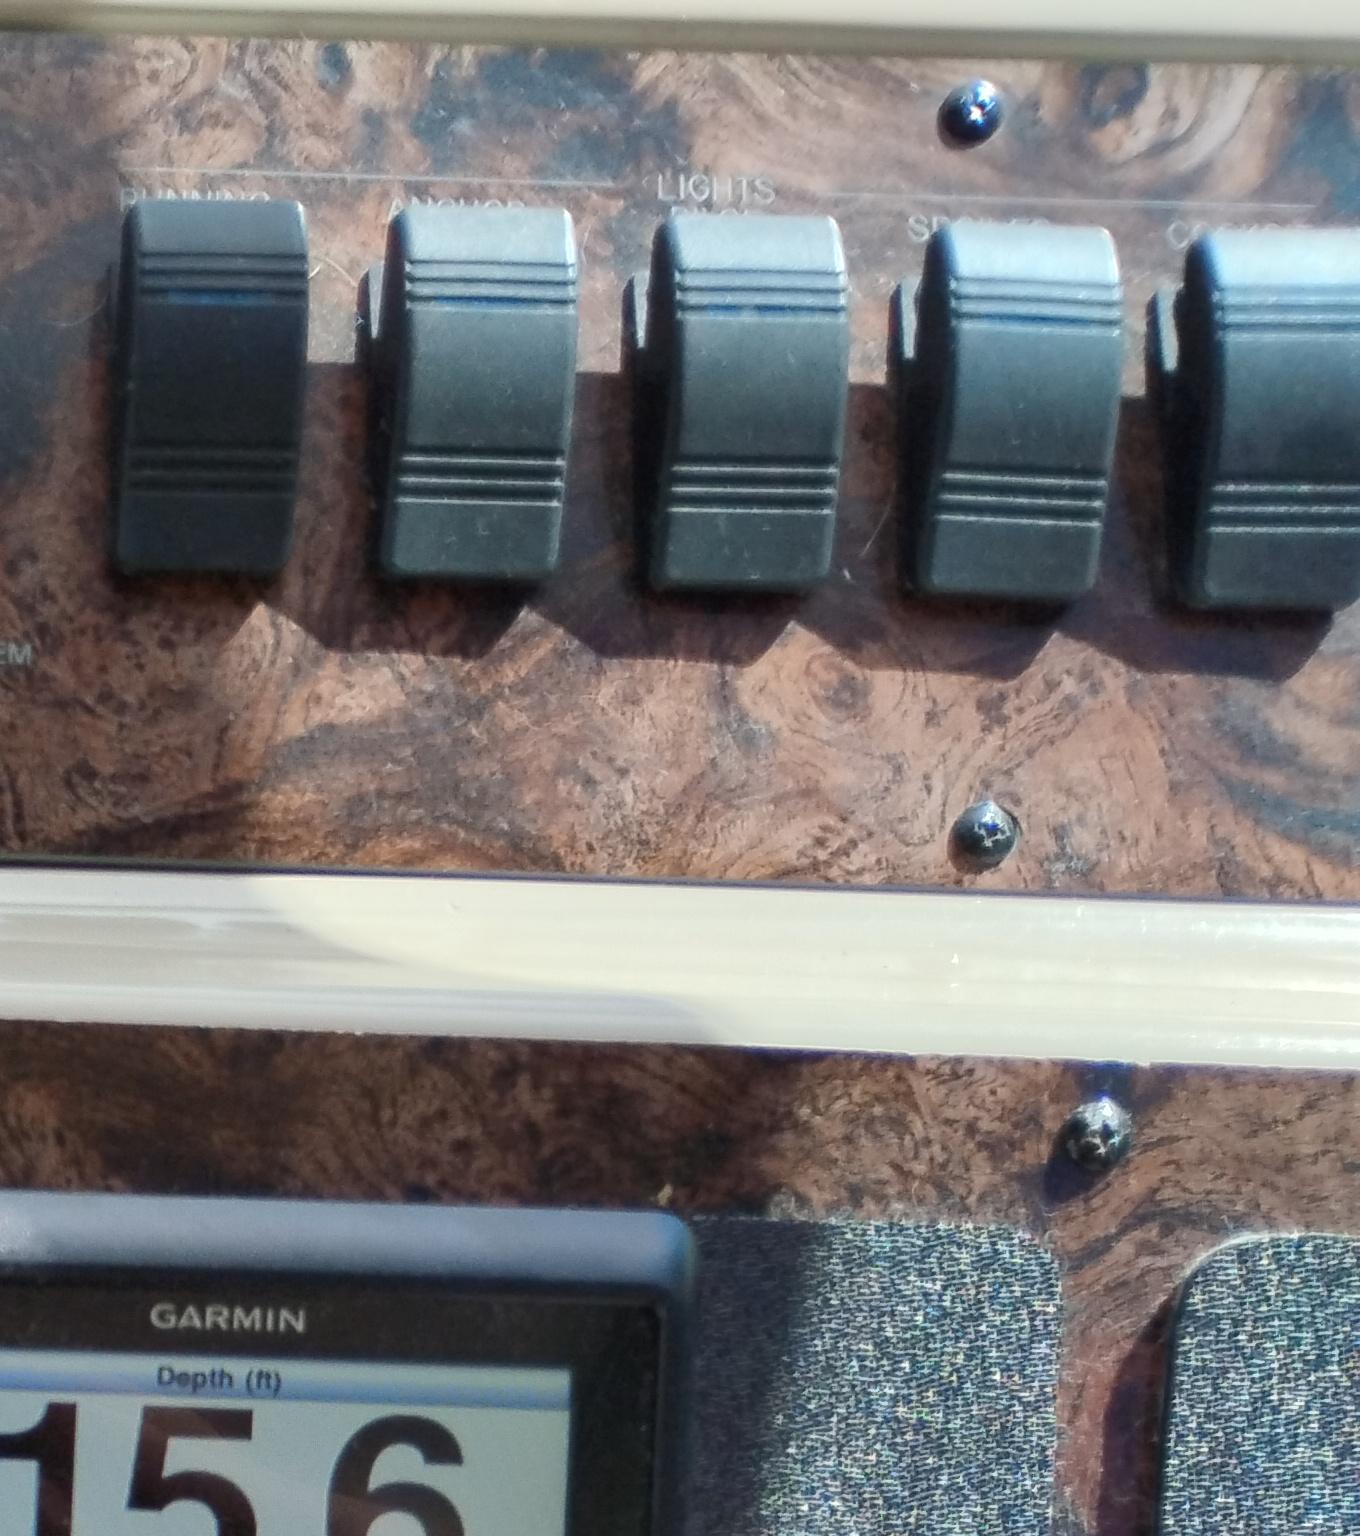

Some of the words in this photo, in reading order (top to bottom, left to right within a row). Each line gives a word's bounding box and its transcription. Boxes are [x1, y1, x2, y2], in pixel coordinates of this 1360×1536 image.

[656, 172, 777, 203] LIGHTS
[150, 1303, 306, 1334] GARMIN
[156, 1366, 234, 1393] Depth
[246, 1368, 281, 1396] (ft)
